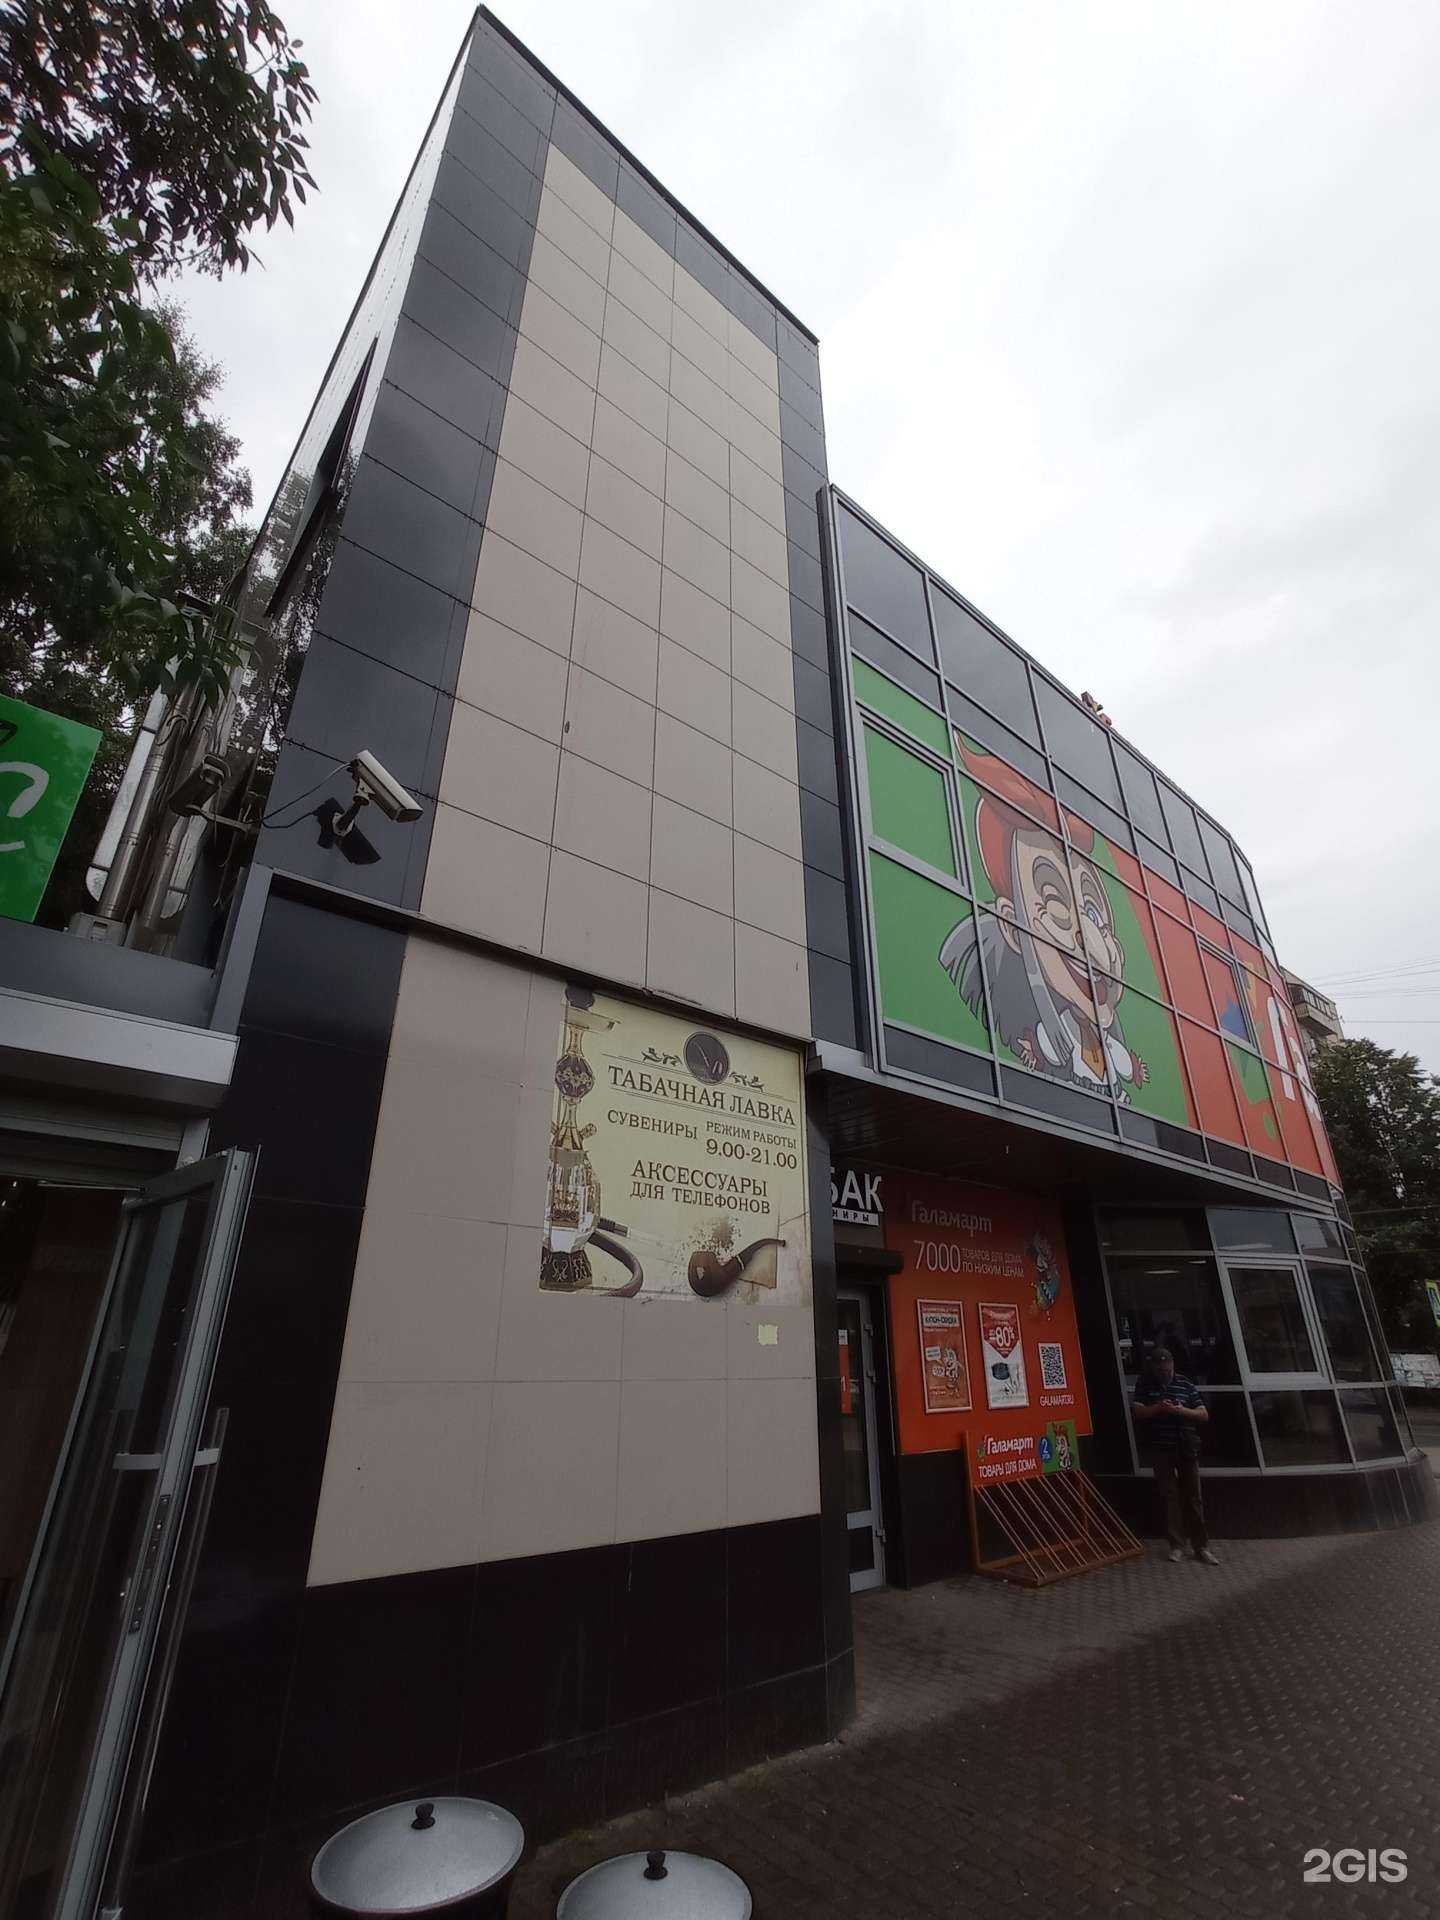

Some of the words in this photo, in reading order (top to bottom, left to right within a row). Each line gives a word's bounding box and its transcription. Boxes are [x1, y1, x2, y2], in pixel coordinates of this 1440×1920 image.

[608, 1065, 725, 1110] ТАБАЧНАЯ
[730, 1094, 795, 1126] ЛАВКА
[608, 1109, 698, 1140] СУВЕНИРЫ
[706, 1121, 750, 1140] РЕЖИМ
[753, 1131, 797, 1149] РАБОТЫ
[706, 1138, 797, 1169] 9.00-21.00
[631, 1159, 768, 1197] АКСЕССУАРЫ
[630, 1181, 664, 1200] ДЛЯ
[672, 1187, 770, 1214] ТЕЛЕФОНОВ
[911, 1199, 993, 1238] Галамарт
[913, 1240, 961, 1273] 7000
[962, 1261, 973, 1273] ПО
[986, 1436, 1033, 1456] Галамарт
[1042, 1438, 1049, 1453] 2
[978, 1462, 1004, 1479] ТОВАРЫ
[1005, 1461, 1018, 1476] ДЛЯ
[1018, 1458, 1037, 1473] ДОМА
